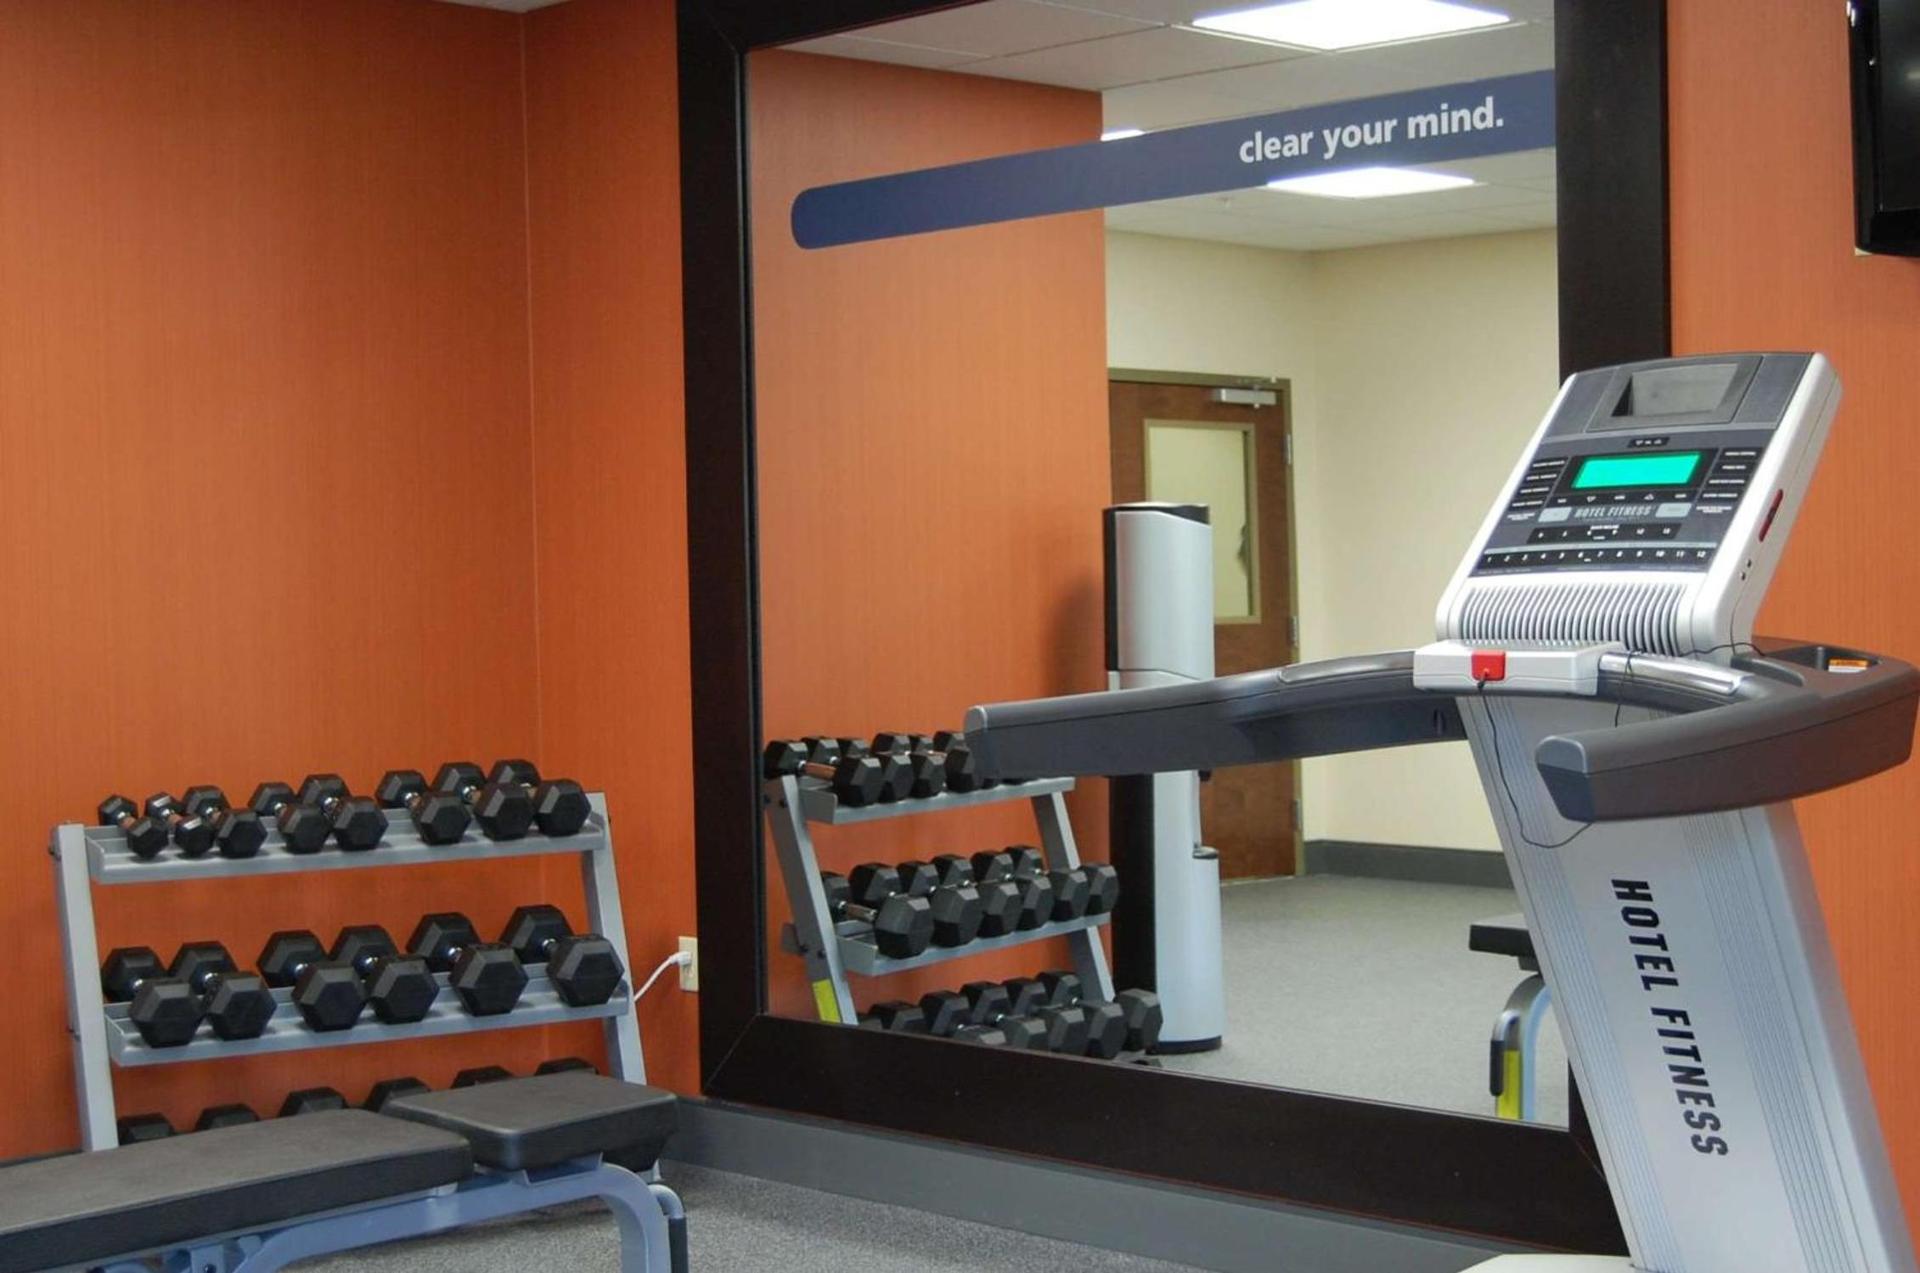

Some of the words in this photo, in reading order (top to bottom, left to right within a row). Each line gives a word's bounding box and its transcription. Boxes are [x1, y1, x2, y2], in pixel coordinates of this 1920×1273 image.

[1239, 130, 1315, 164] clear
[1322, 117, 1397, 160] your
[1407, 96, 1504, 139] mind.
[1574, 507, 1605, 519] HOTEL
[1607, 505, 1651, 517] FITNESS
[1610, 878, 1680, 992] HOTEL
[1650, 1006, 1729, 1157] FITNESS
